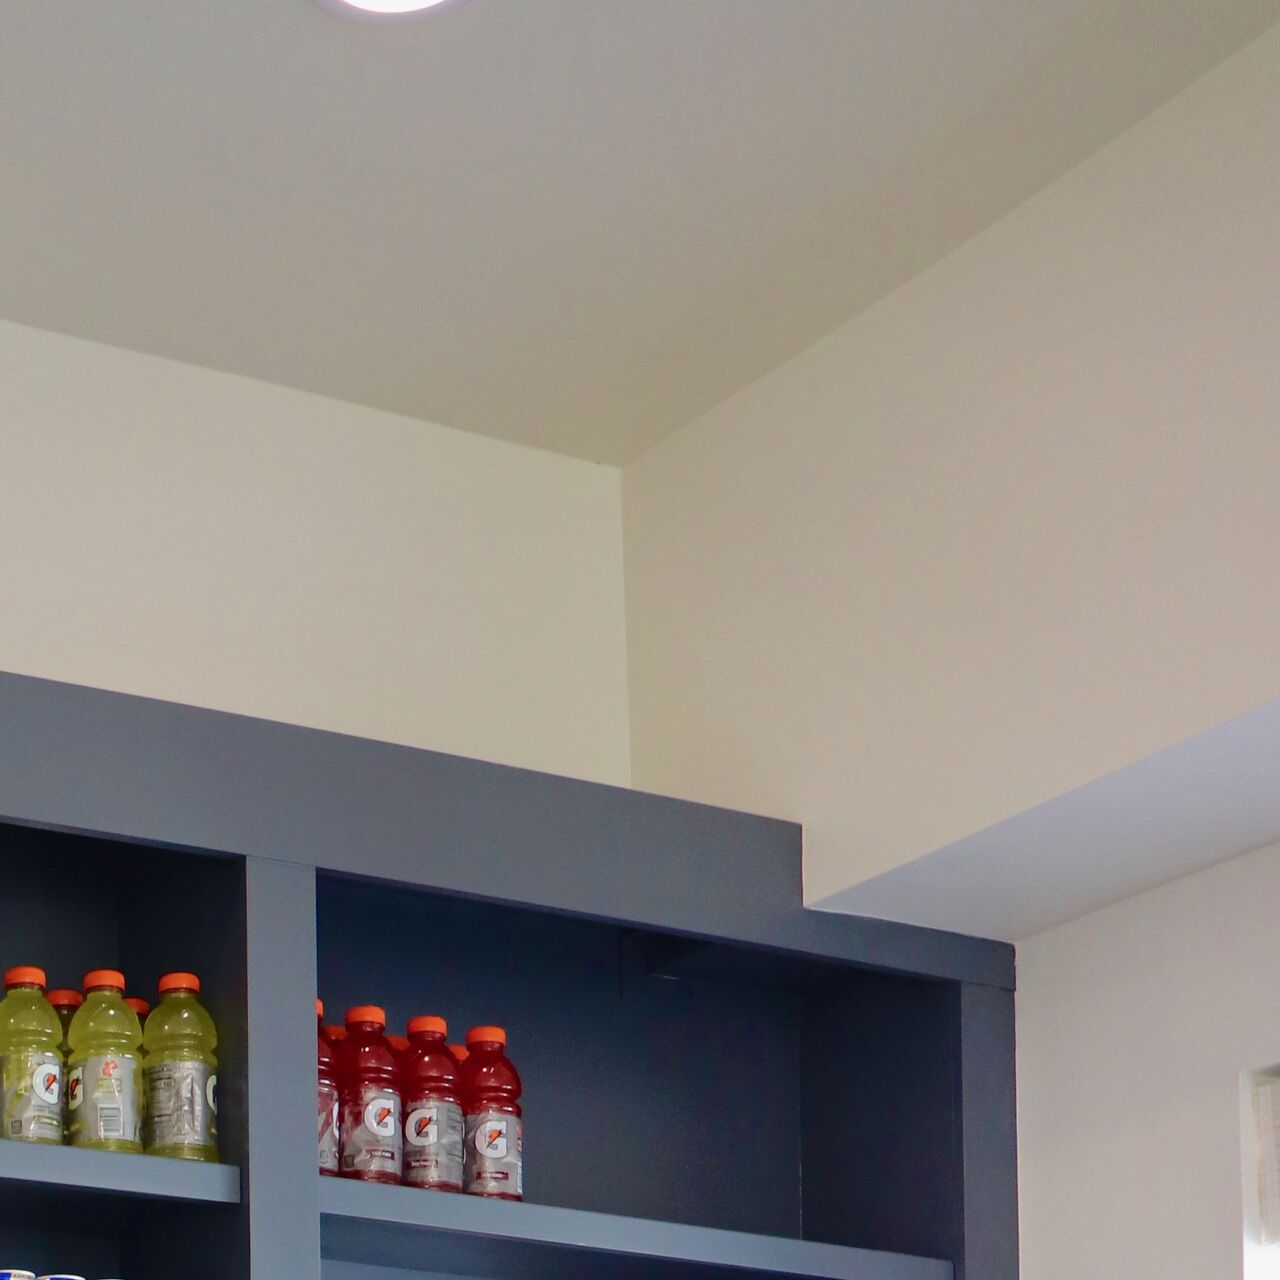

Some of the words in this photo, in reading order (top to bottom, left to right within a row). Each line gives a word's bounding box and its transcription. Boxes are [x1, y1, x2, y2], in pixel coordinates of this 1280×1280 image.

[32, 1063, 59, 1102] G
[364, 1098, 395, 1136] G
[405, 1108, 438, 1146] G
[475, 1120, 508, 1158] G
